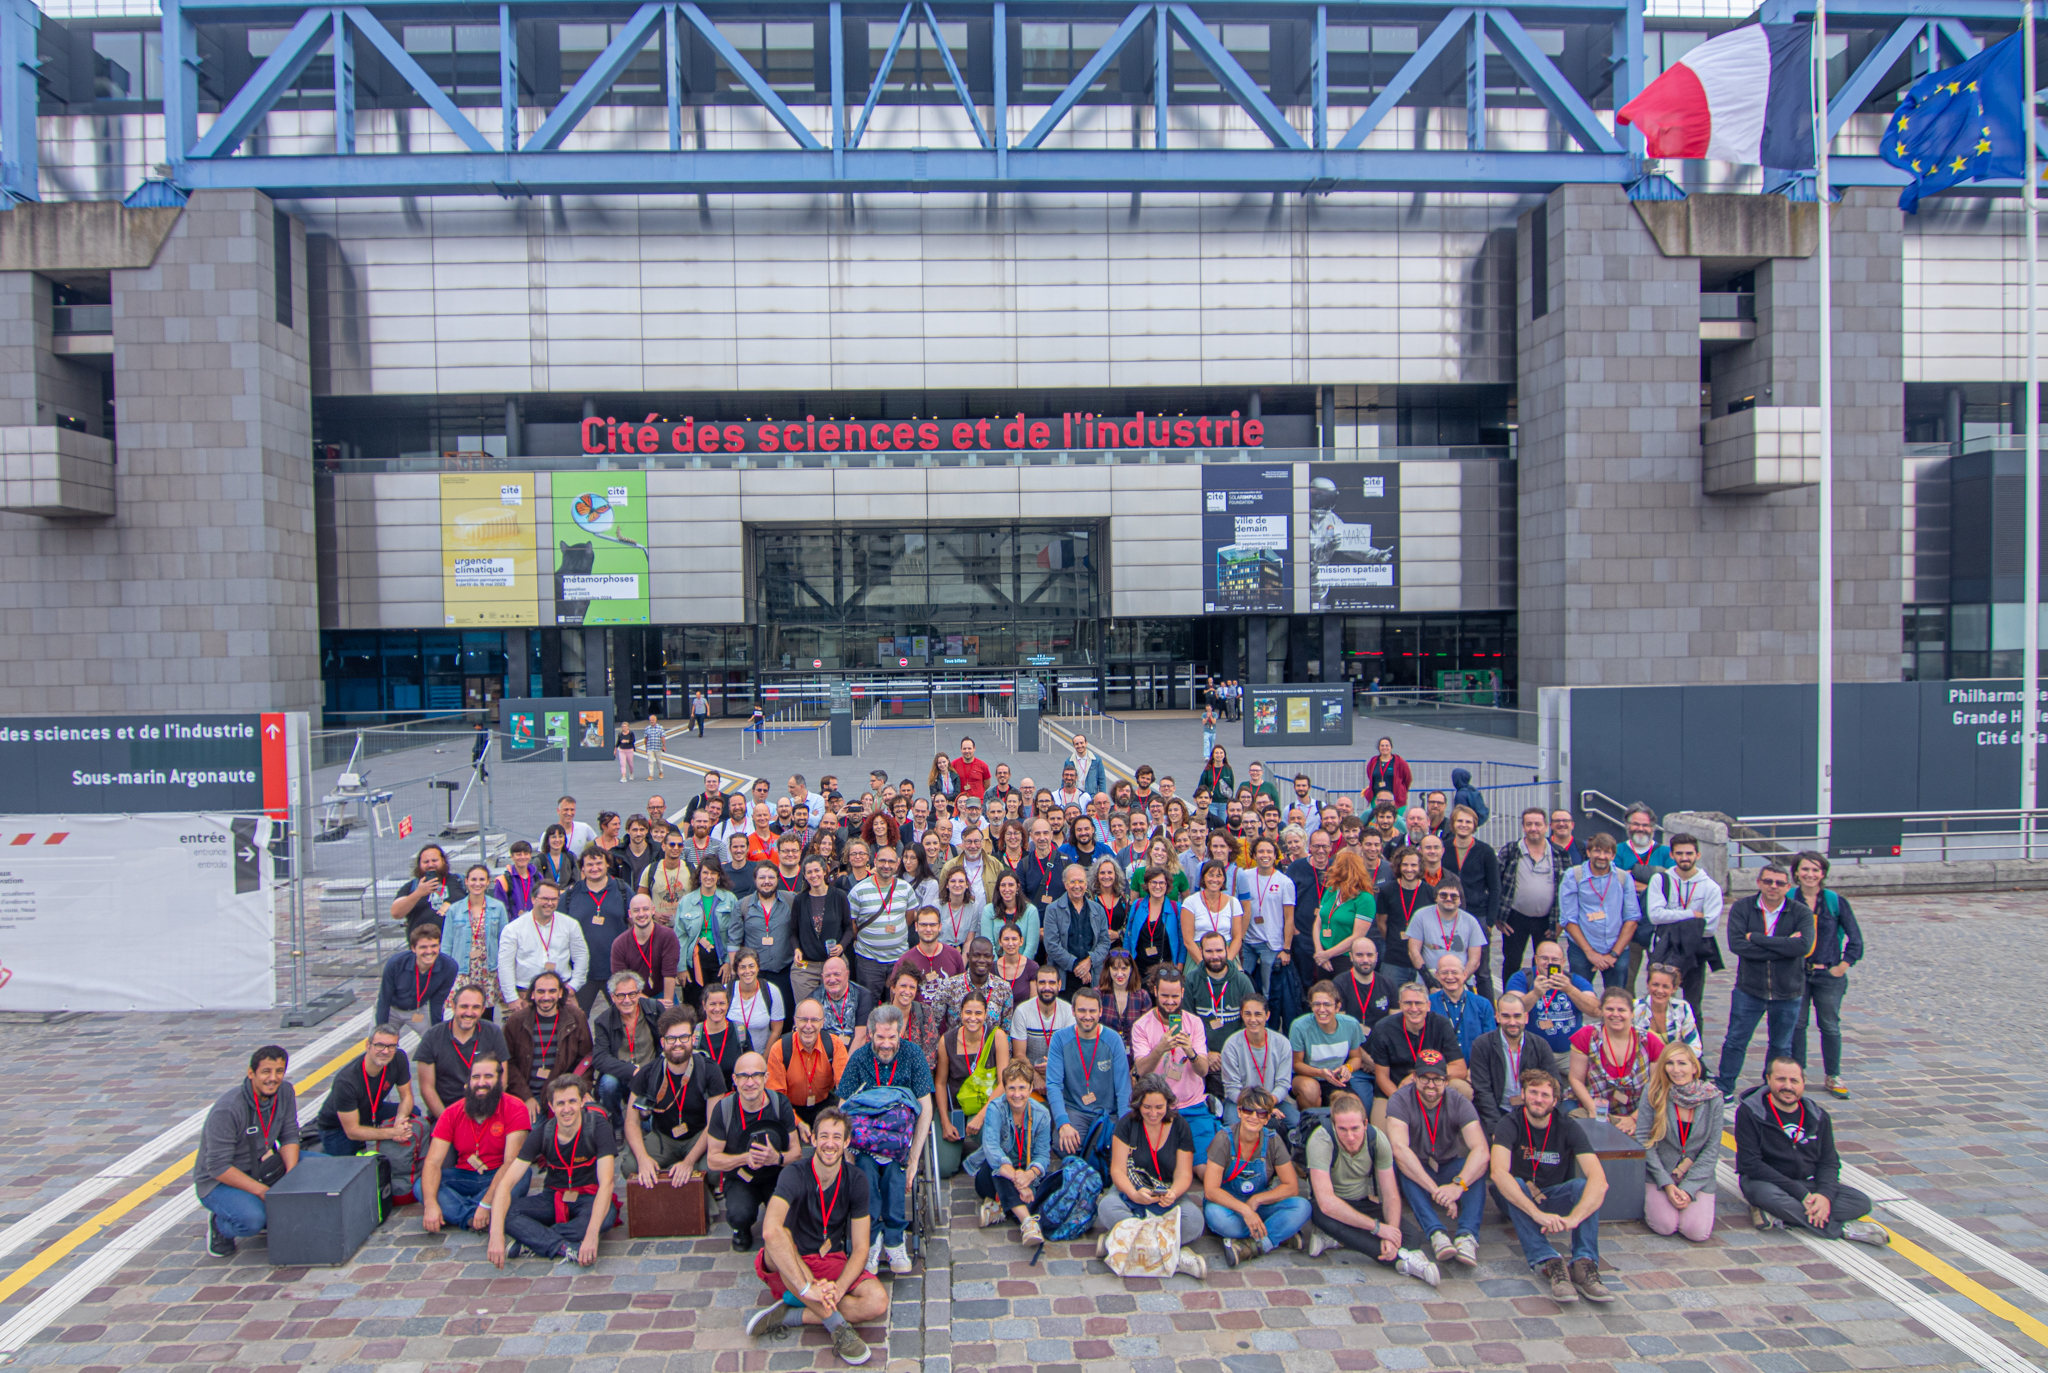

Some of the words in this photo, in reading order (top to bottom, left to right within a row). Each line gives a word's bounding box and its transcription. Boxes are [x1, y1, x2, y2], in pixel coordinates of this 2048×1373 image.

[581, 412, 659, 454] Cité
[672, 416, 745, 453] des
[758, 414, 939, 452] sciences
[952, 418, 991, 450] et
[1003, 413, 1050, 449] de
[1063, 410, 1265, 449] l'industrie
[1364, 476, 1381, 486] cité
[501, 485, 519, 494] cité
[608, 486, 625, 495] cité
[1207, 491, 1224, 500] cité
[1235, 516, 1254, 524] ville
[1255, 516, 1267, 524] de
[1235, 525, 1268, 533] demain
[1342, 527, 1367, 547] MARS
[455, 557, 493, 567] urgence
[455, 565, 504, 575] climatique
[1317, 566, 1351, 574] mission
[1353, 565, 1387, 574] spatiale
[564, 574, 634, 584] métamorphoses
[1948, 688, 2048, 703] Philharmoie
[1952, 710, 2008, 725] Grande
[2010, 709, 2048, 723] Hle
[0, 726, 31, 741] des
[33, 725, 111, 741] sciences
[116, 726, 135, 740] et
[139, 724, 160, 740] de
[164, 722, 255, 739] l'industrie
[1977, 730, 2008, 746] Cité
[72, 769, 166, 786] Sous-marin
[169, 768, 257, 788] Argonaute
[180, 831, 226, 844] entrée
[197, 860, 227, 869] entrada
